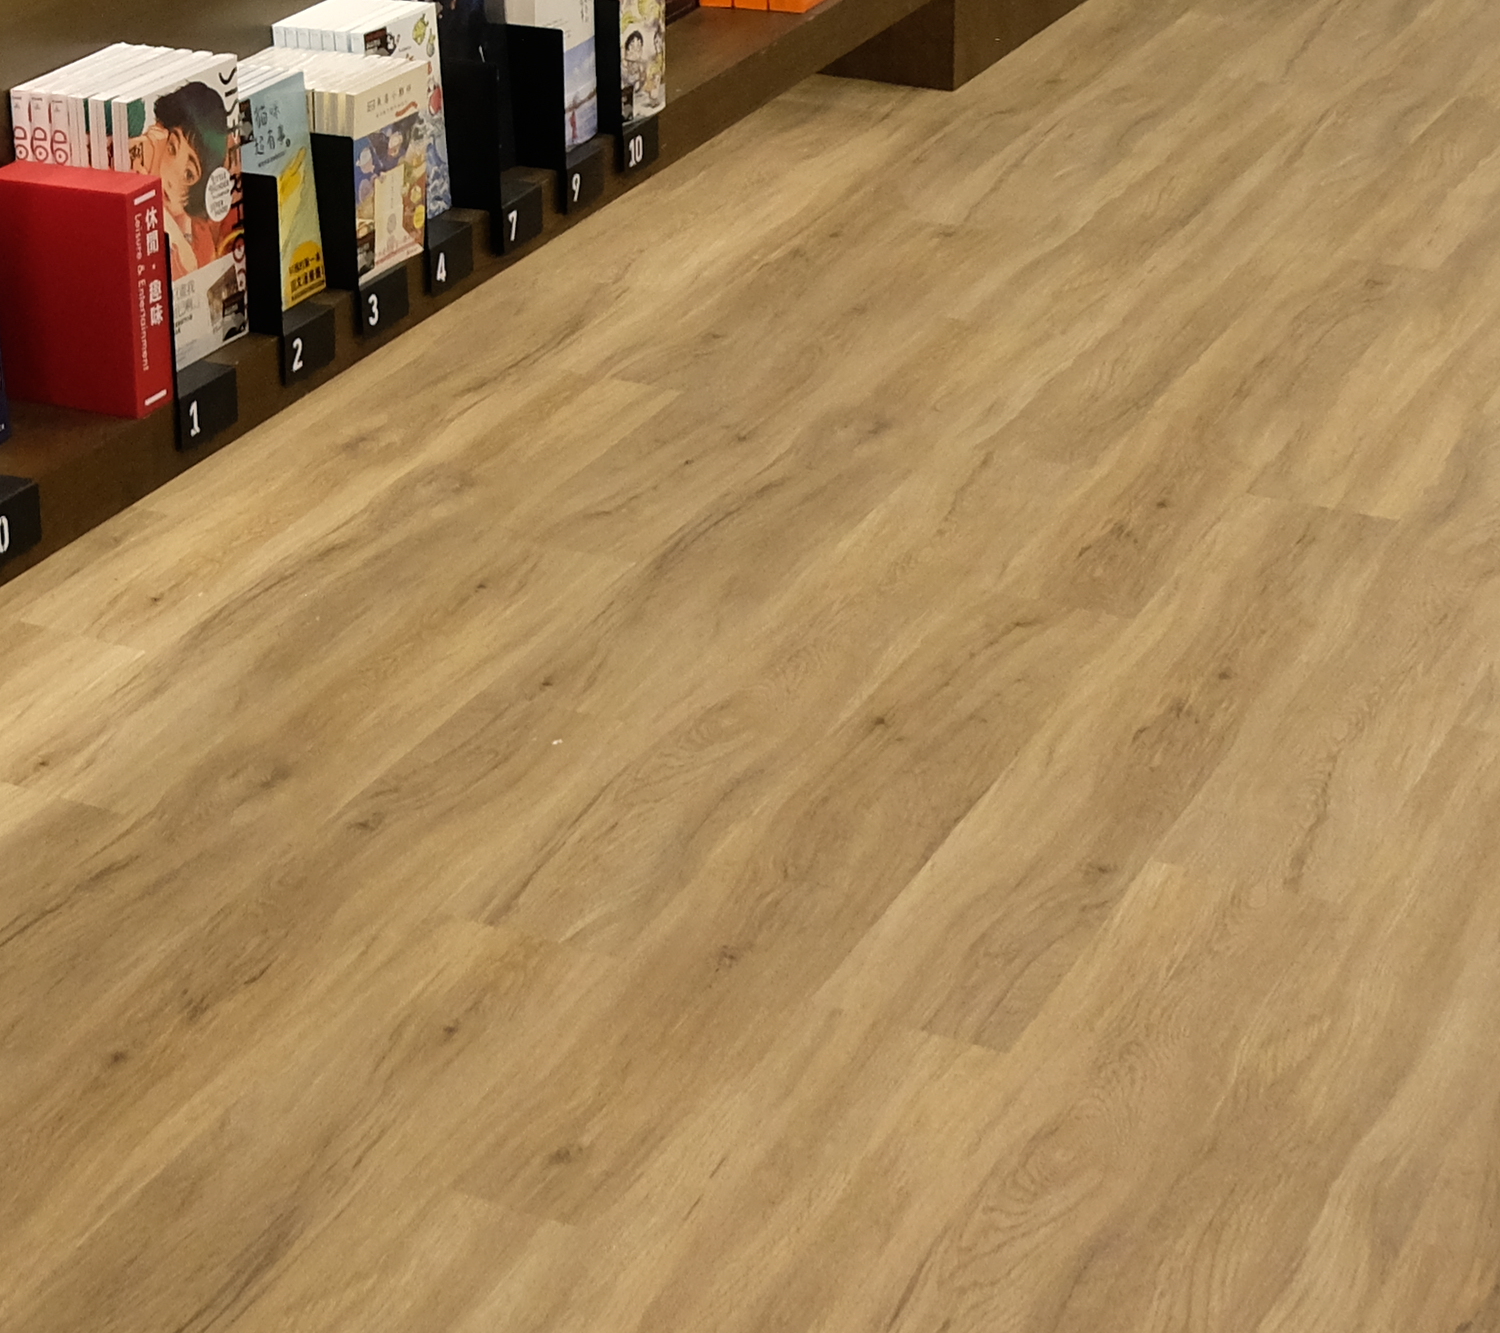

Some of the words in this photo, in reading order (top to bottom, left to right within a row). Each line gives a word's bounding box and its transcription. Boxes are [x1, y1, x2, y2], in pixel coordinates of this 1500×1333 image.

[628, 134, 644, 168] 10
[571, 173, 582, 202] 9
[133, 213, 143, 263] Leisure
[435, 252, 447, 283] 4
[137, 278, 150, 372] Entertainment
[367, 293, 379, 325] 3
[291, 338, 304, 372] 2
[189, 399, 200, 437] 1
